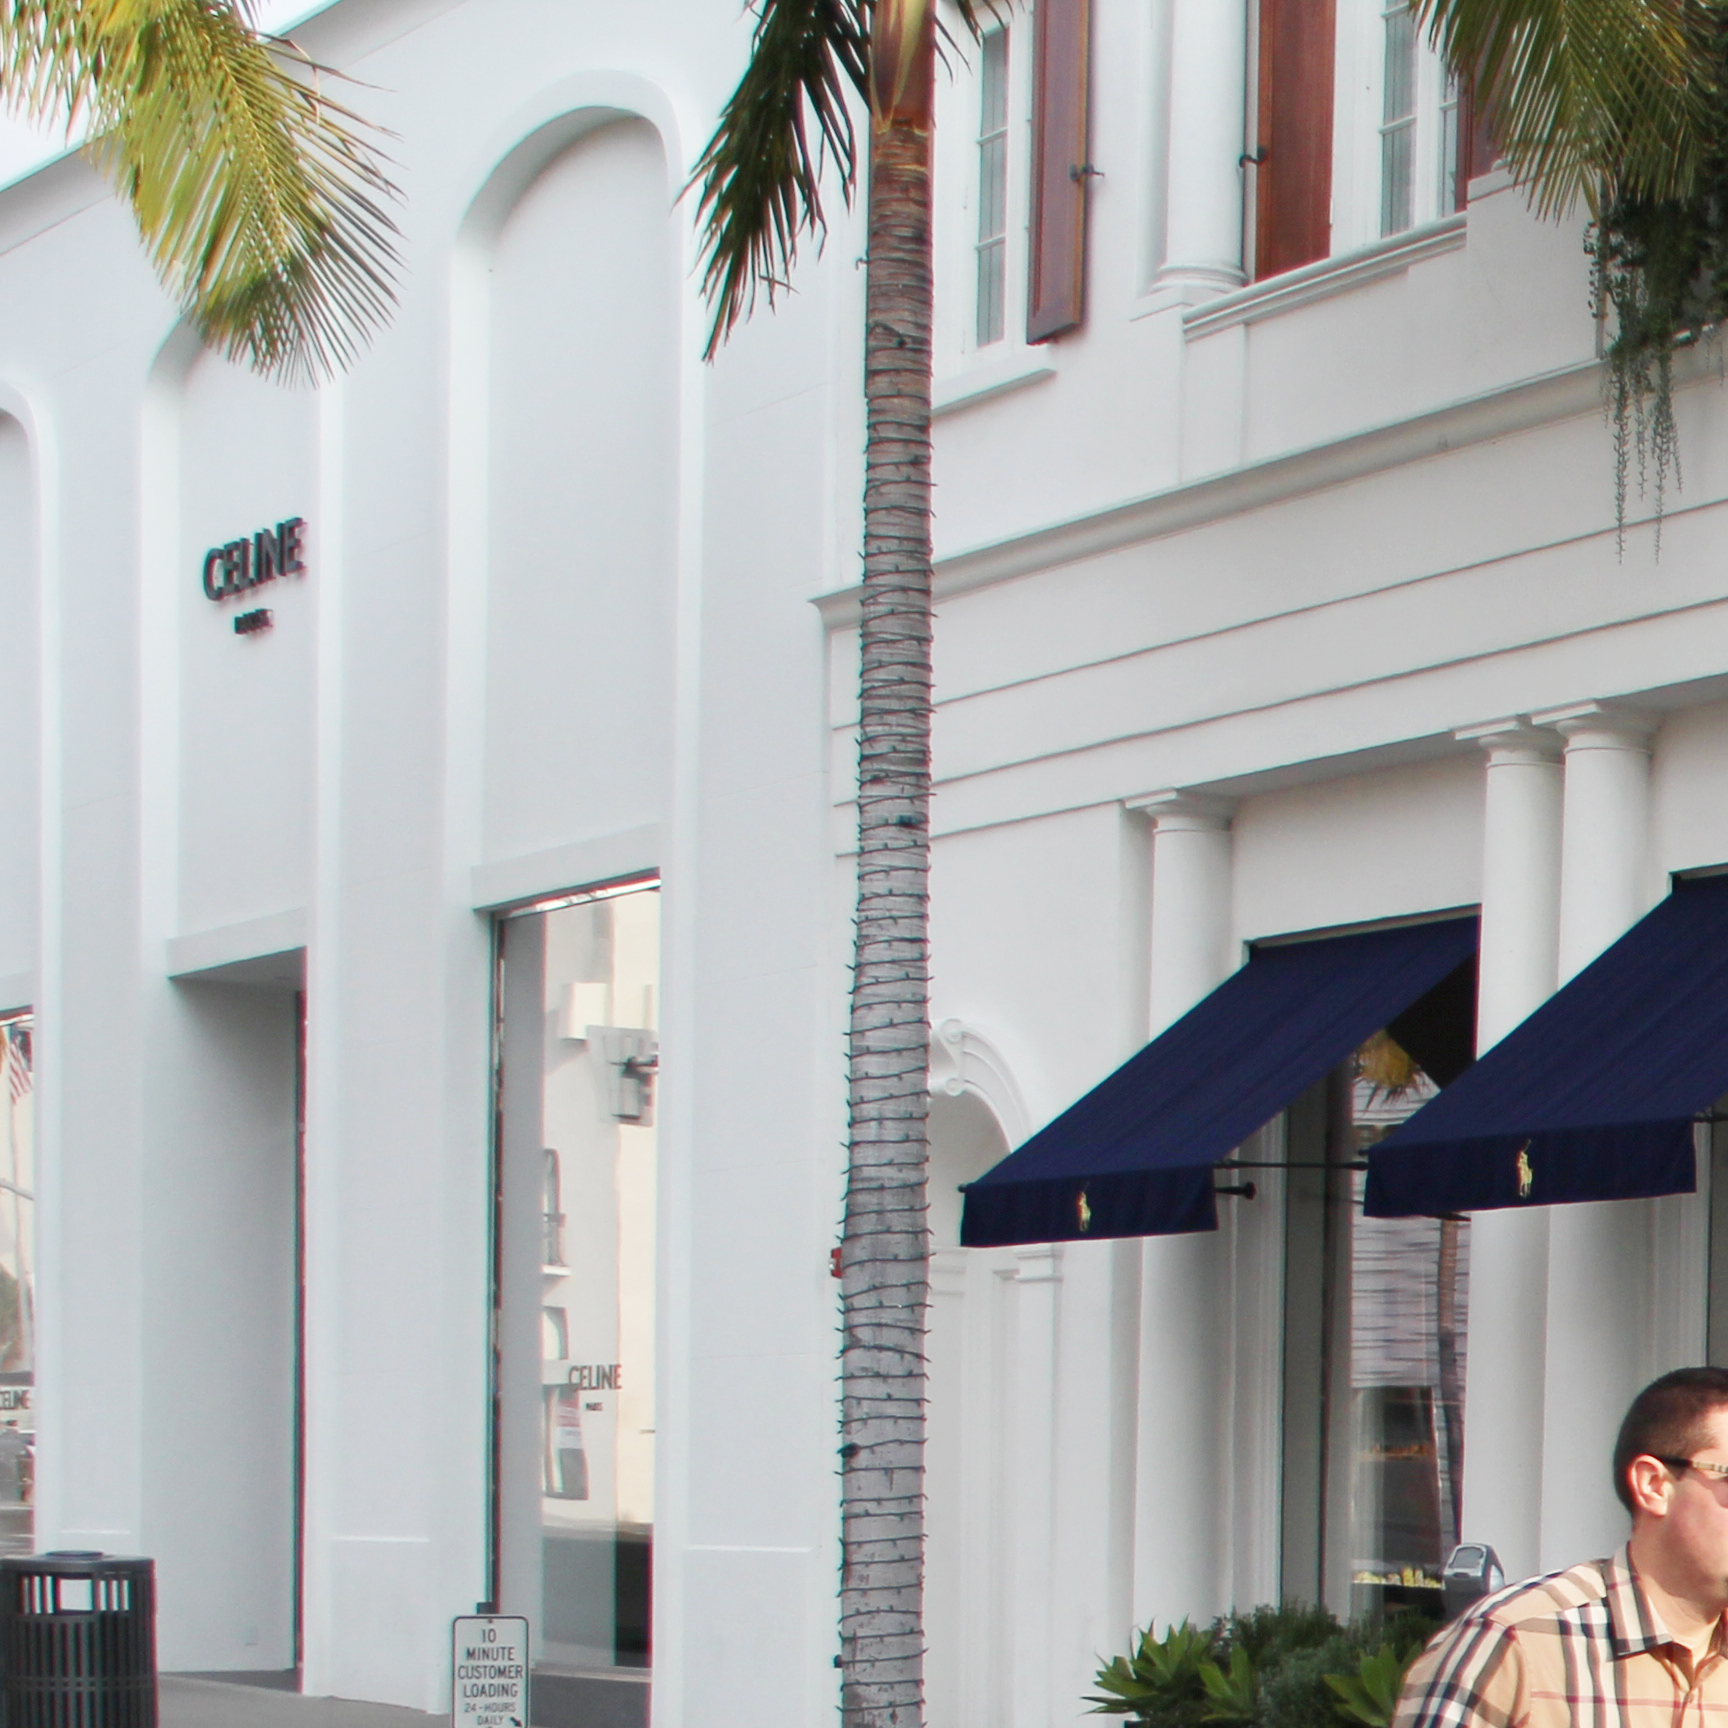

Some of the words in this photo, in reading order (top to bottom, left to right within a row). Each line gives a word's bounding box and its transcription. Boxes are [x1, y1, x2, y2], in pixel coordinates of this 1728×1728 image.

[203, 516, 305, 602] CELINE
[568, 1364, 622, 1392] CELINE
[481, 1627, 497, 1643] 10
[467, 1646, 515, 1661] MINUTE
[457, 1665, 523, 1680] CUSTOMER
[463, 1683, 519, 1698] LOADING
[477, 1714, 504, 1726] DAILY
